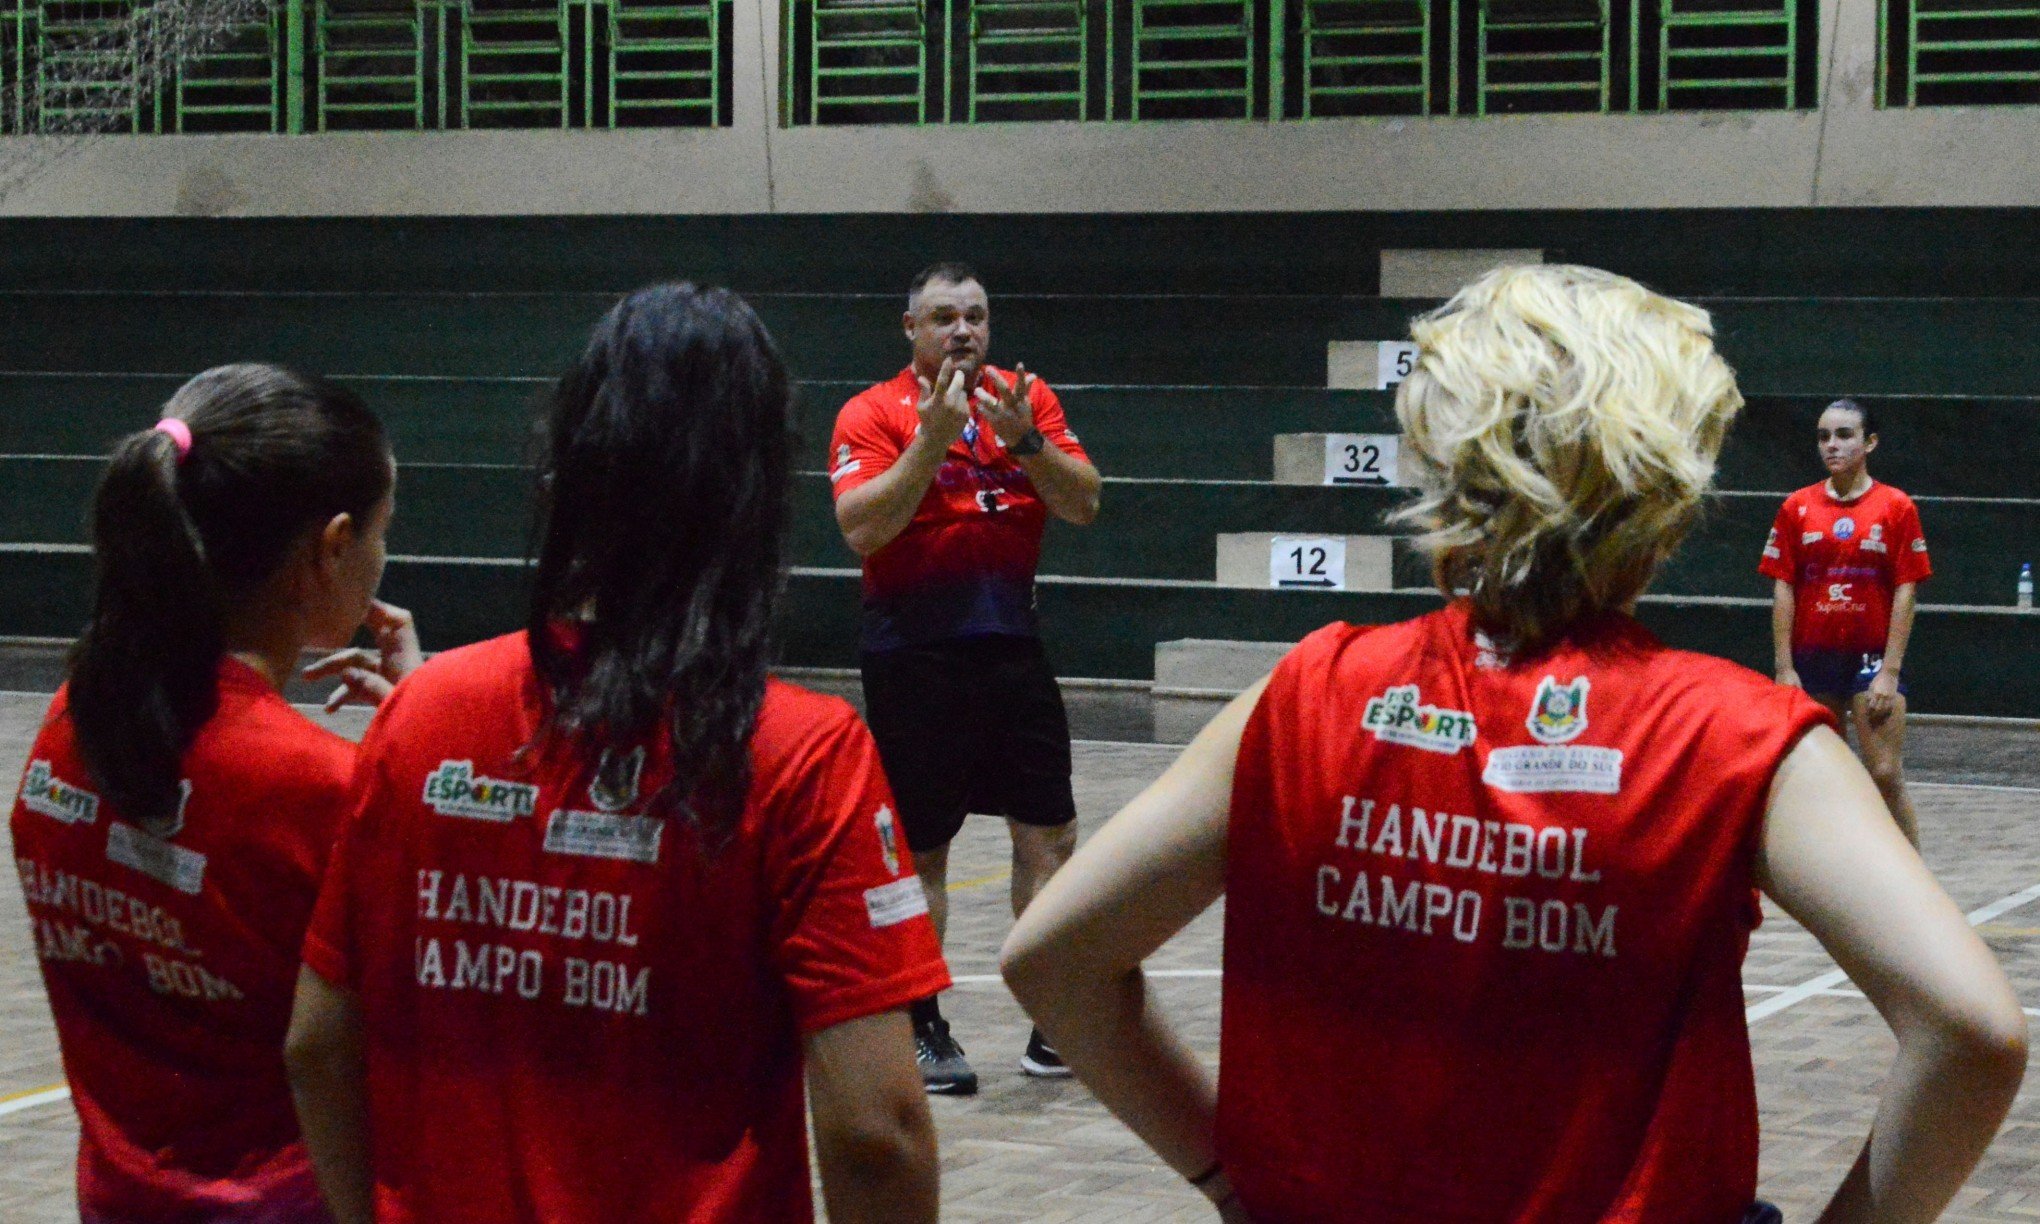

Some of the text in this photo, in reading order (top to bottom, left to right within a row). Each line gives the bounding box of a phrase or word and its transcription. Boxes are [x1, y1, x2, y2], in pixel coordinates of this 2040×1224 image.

[1344, 444, 1380, 473] 32
[1290, 546, 1327, 575] 12
[1335, 795, 1601, 882] HANDEBOL
[417, 868, 639, 946] HANDEBOL
[1316, 864, 1620, 957] CAMPO BOM
[415, 936, 651, 1015] AMPO BOM
